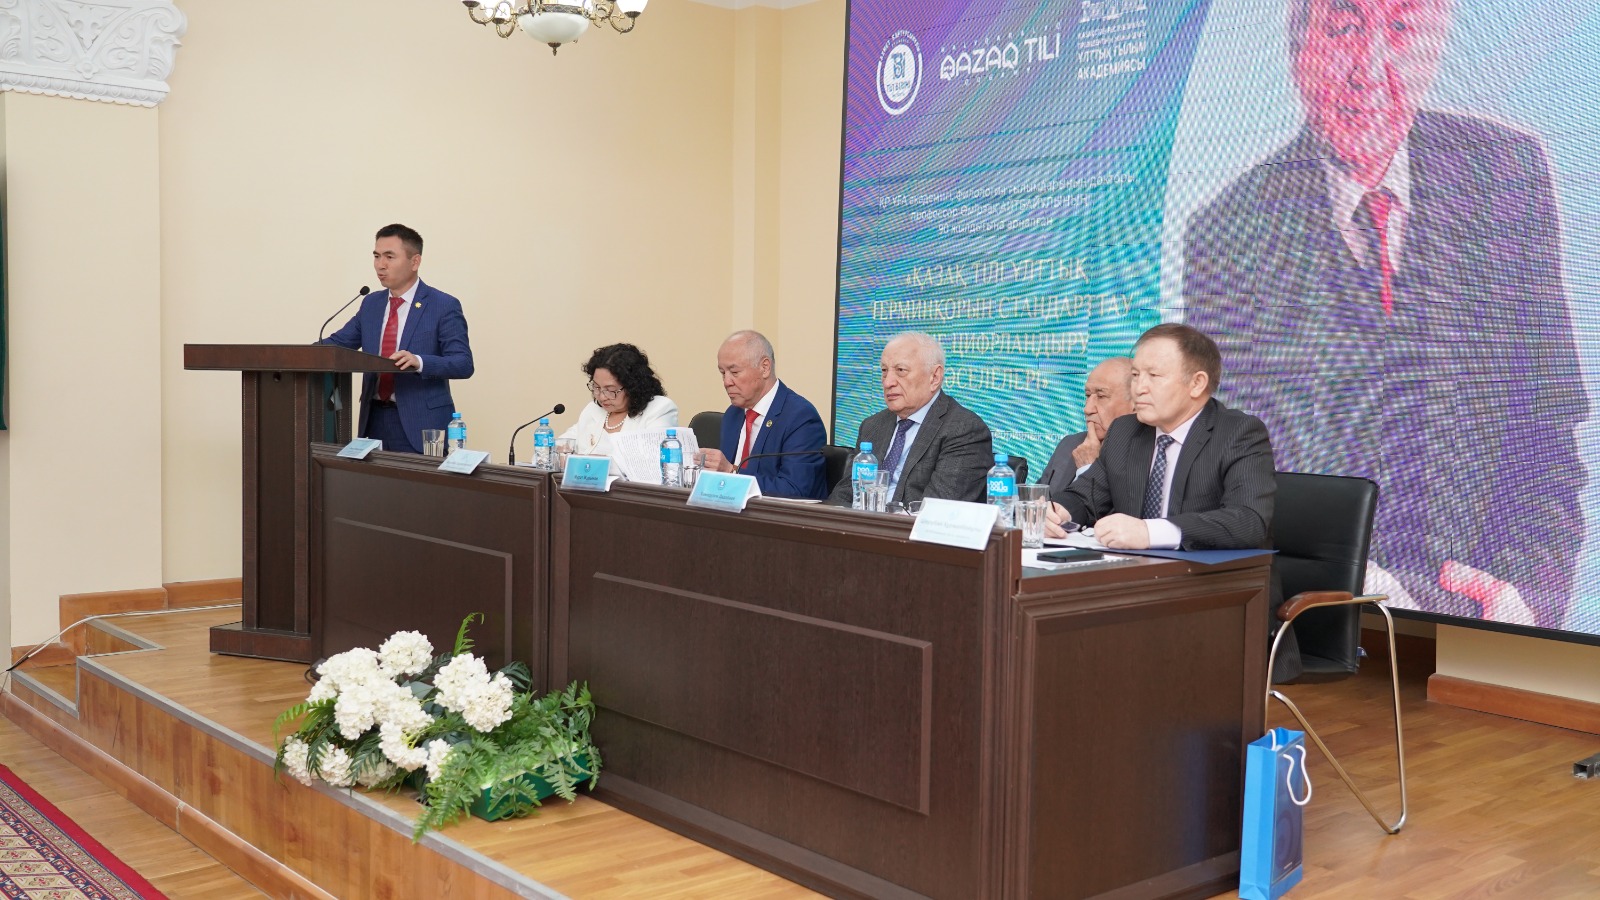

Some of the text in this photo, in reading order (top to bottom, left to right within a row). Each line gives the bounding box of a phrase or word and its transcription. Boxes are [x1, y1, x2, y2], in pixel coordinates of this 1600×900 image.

[940, 42, 1019, 80] QAZAQ
[1024, 33, 1060, 63] TILI
[1077, 57, 1147, 80] АКАДЕМИЯСЫ
[938, 222, 949, 235] 90
[998, 292, 1134, 322] СТАНДАРТТАУ
[952, 331, 1089, 358] ЦИФРЛАНДЫРУ
[944, 366, 1049, 390] ӘСЕЛЕЛЕРІ»
